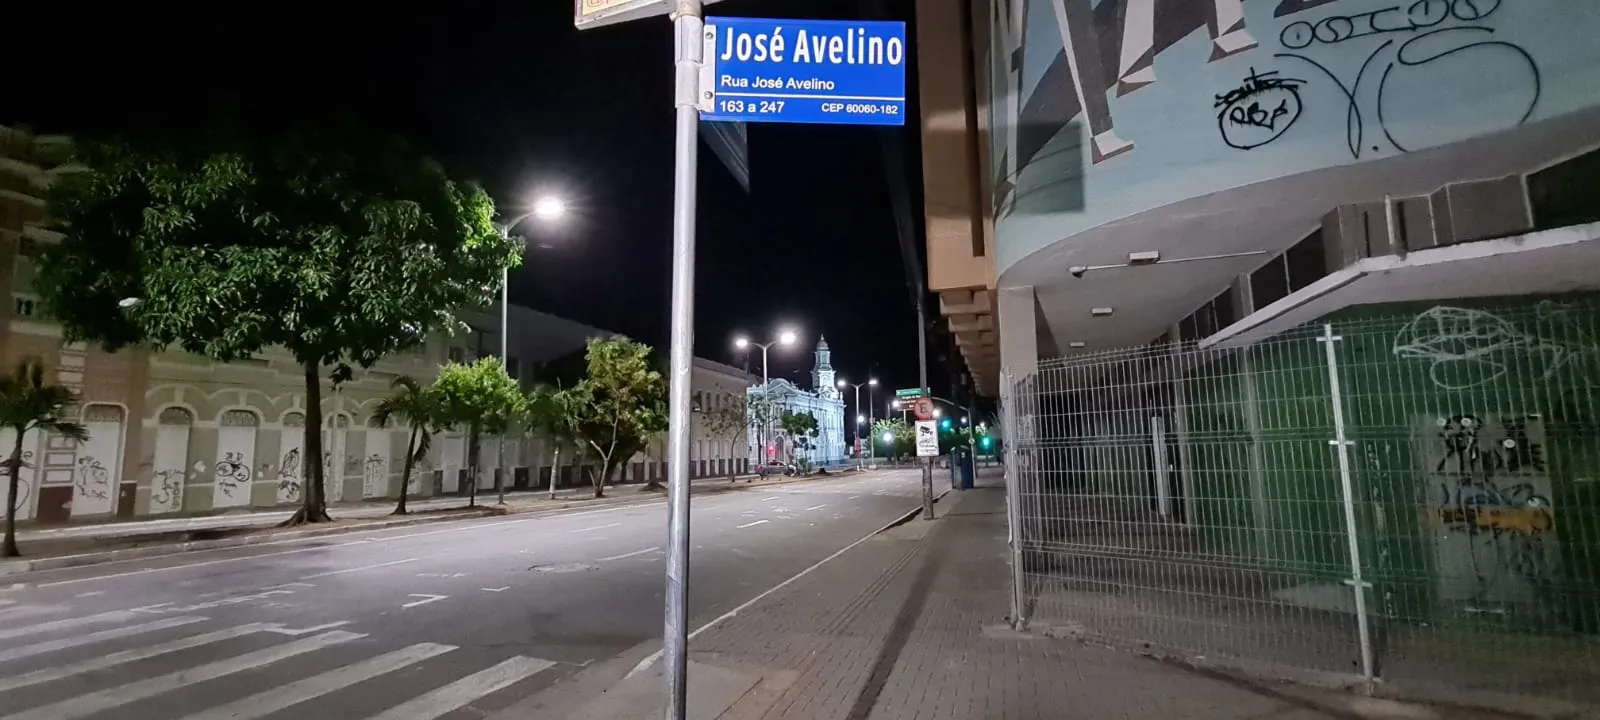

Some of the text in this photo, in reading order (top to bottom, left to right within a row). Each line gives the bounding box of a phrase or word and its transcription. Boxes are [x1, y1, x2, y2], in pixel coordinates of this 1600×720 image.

[720, 26, 903, 66] José Avelino
[721, 75, 835, 91] Rua José Avelino
[720, 101, 785, 113] 163 a 247
[821, 102, 898, 115] CEP 60060-182
